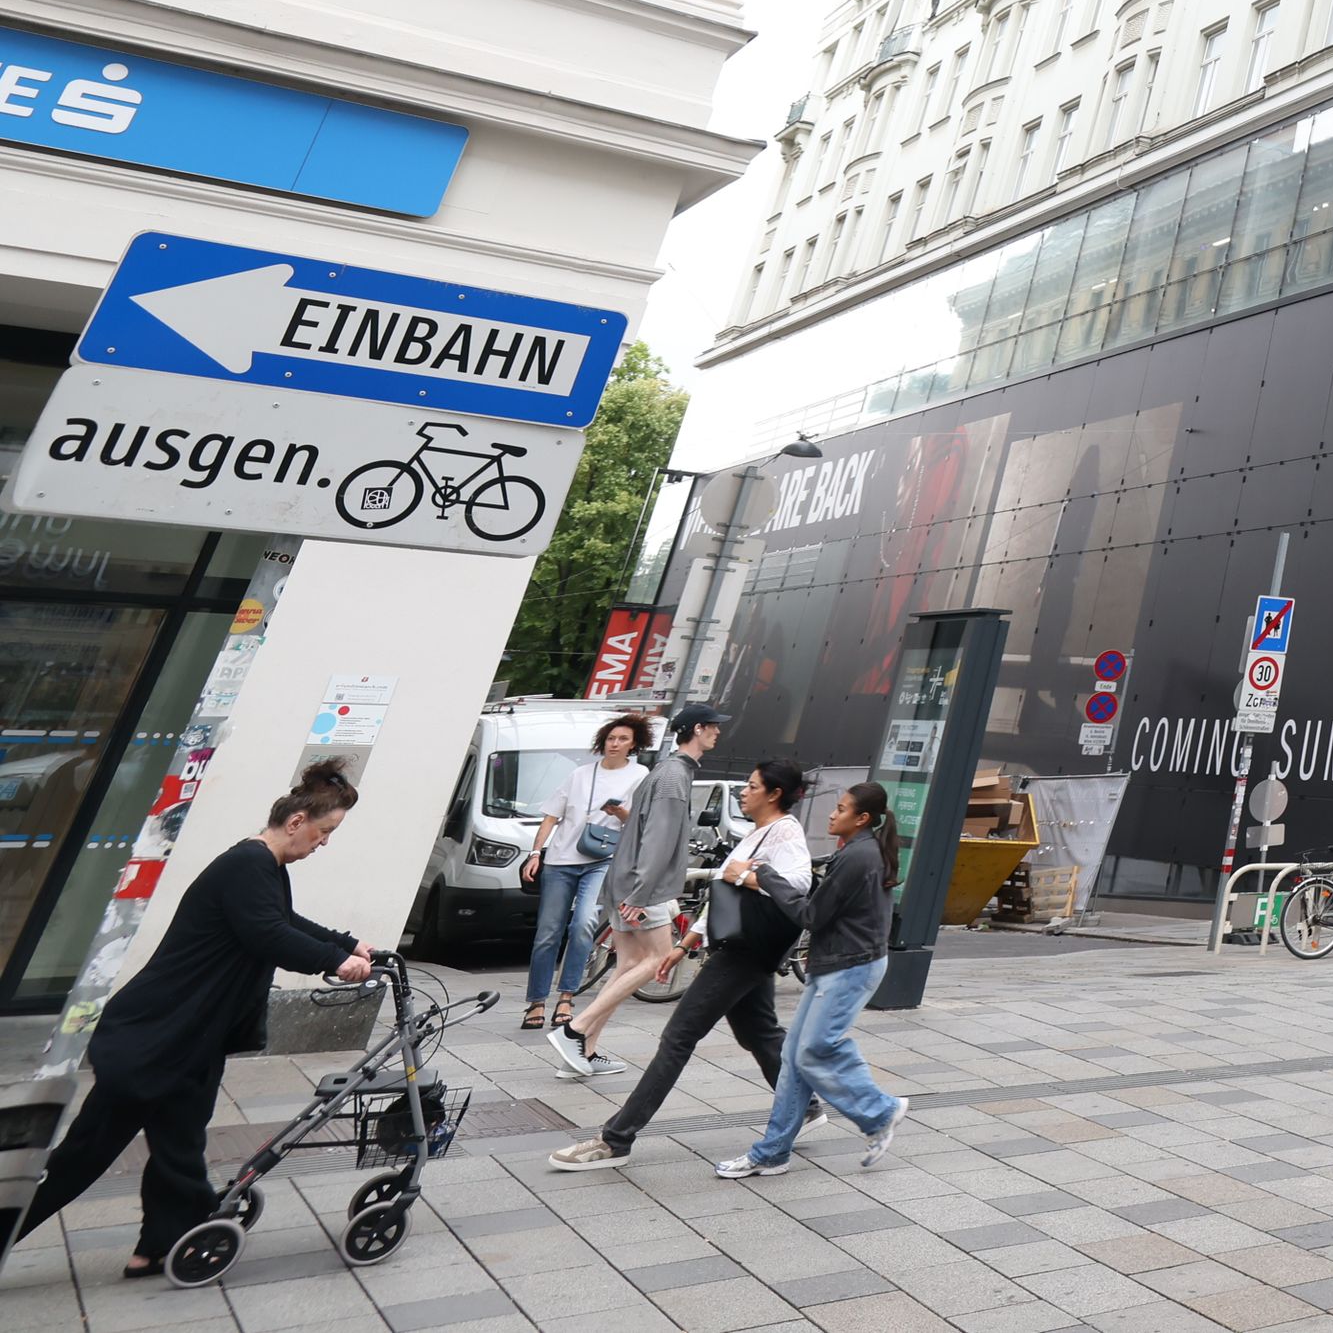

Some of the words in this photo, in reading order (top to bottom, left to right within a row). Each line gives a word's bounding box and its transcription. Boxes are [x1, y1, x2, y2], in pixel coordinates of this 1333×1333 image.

[280, 298, 566, 386] EINBAHN
[49, 418, 332, 488] ausgen.
[806, 449, 876, 525] BACK
[588, 631, 639, 700] EMA
[1256, 664, 1272, 682] 30
